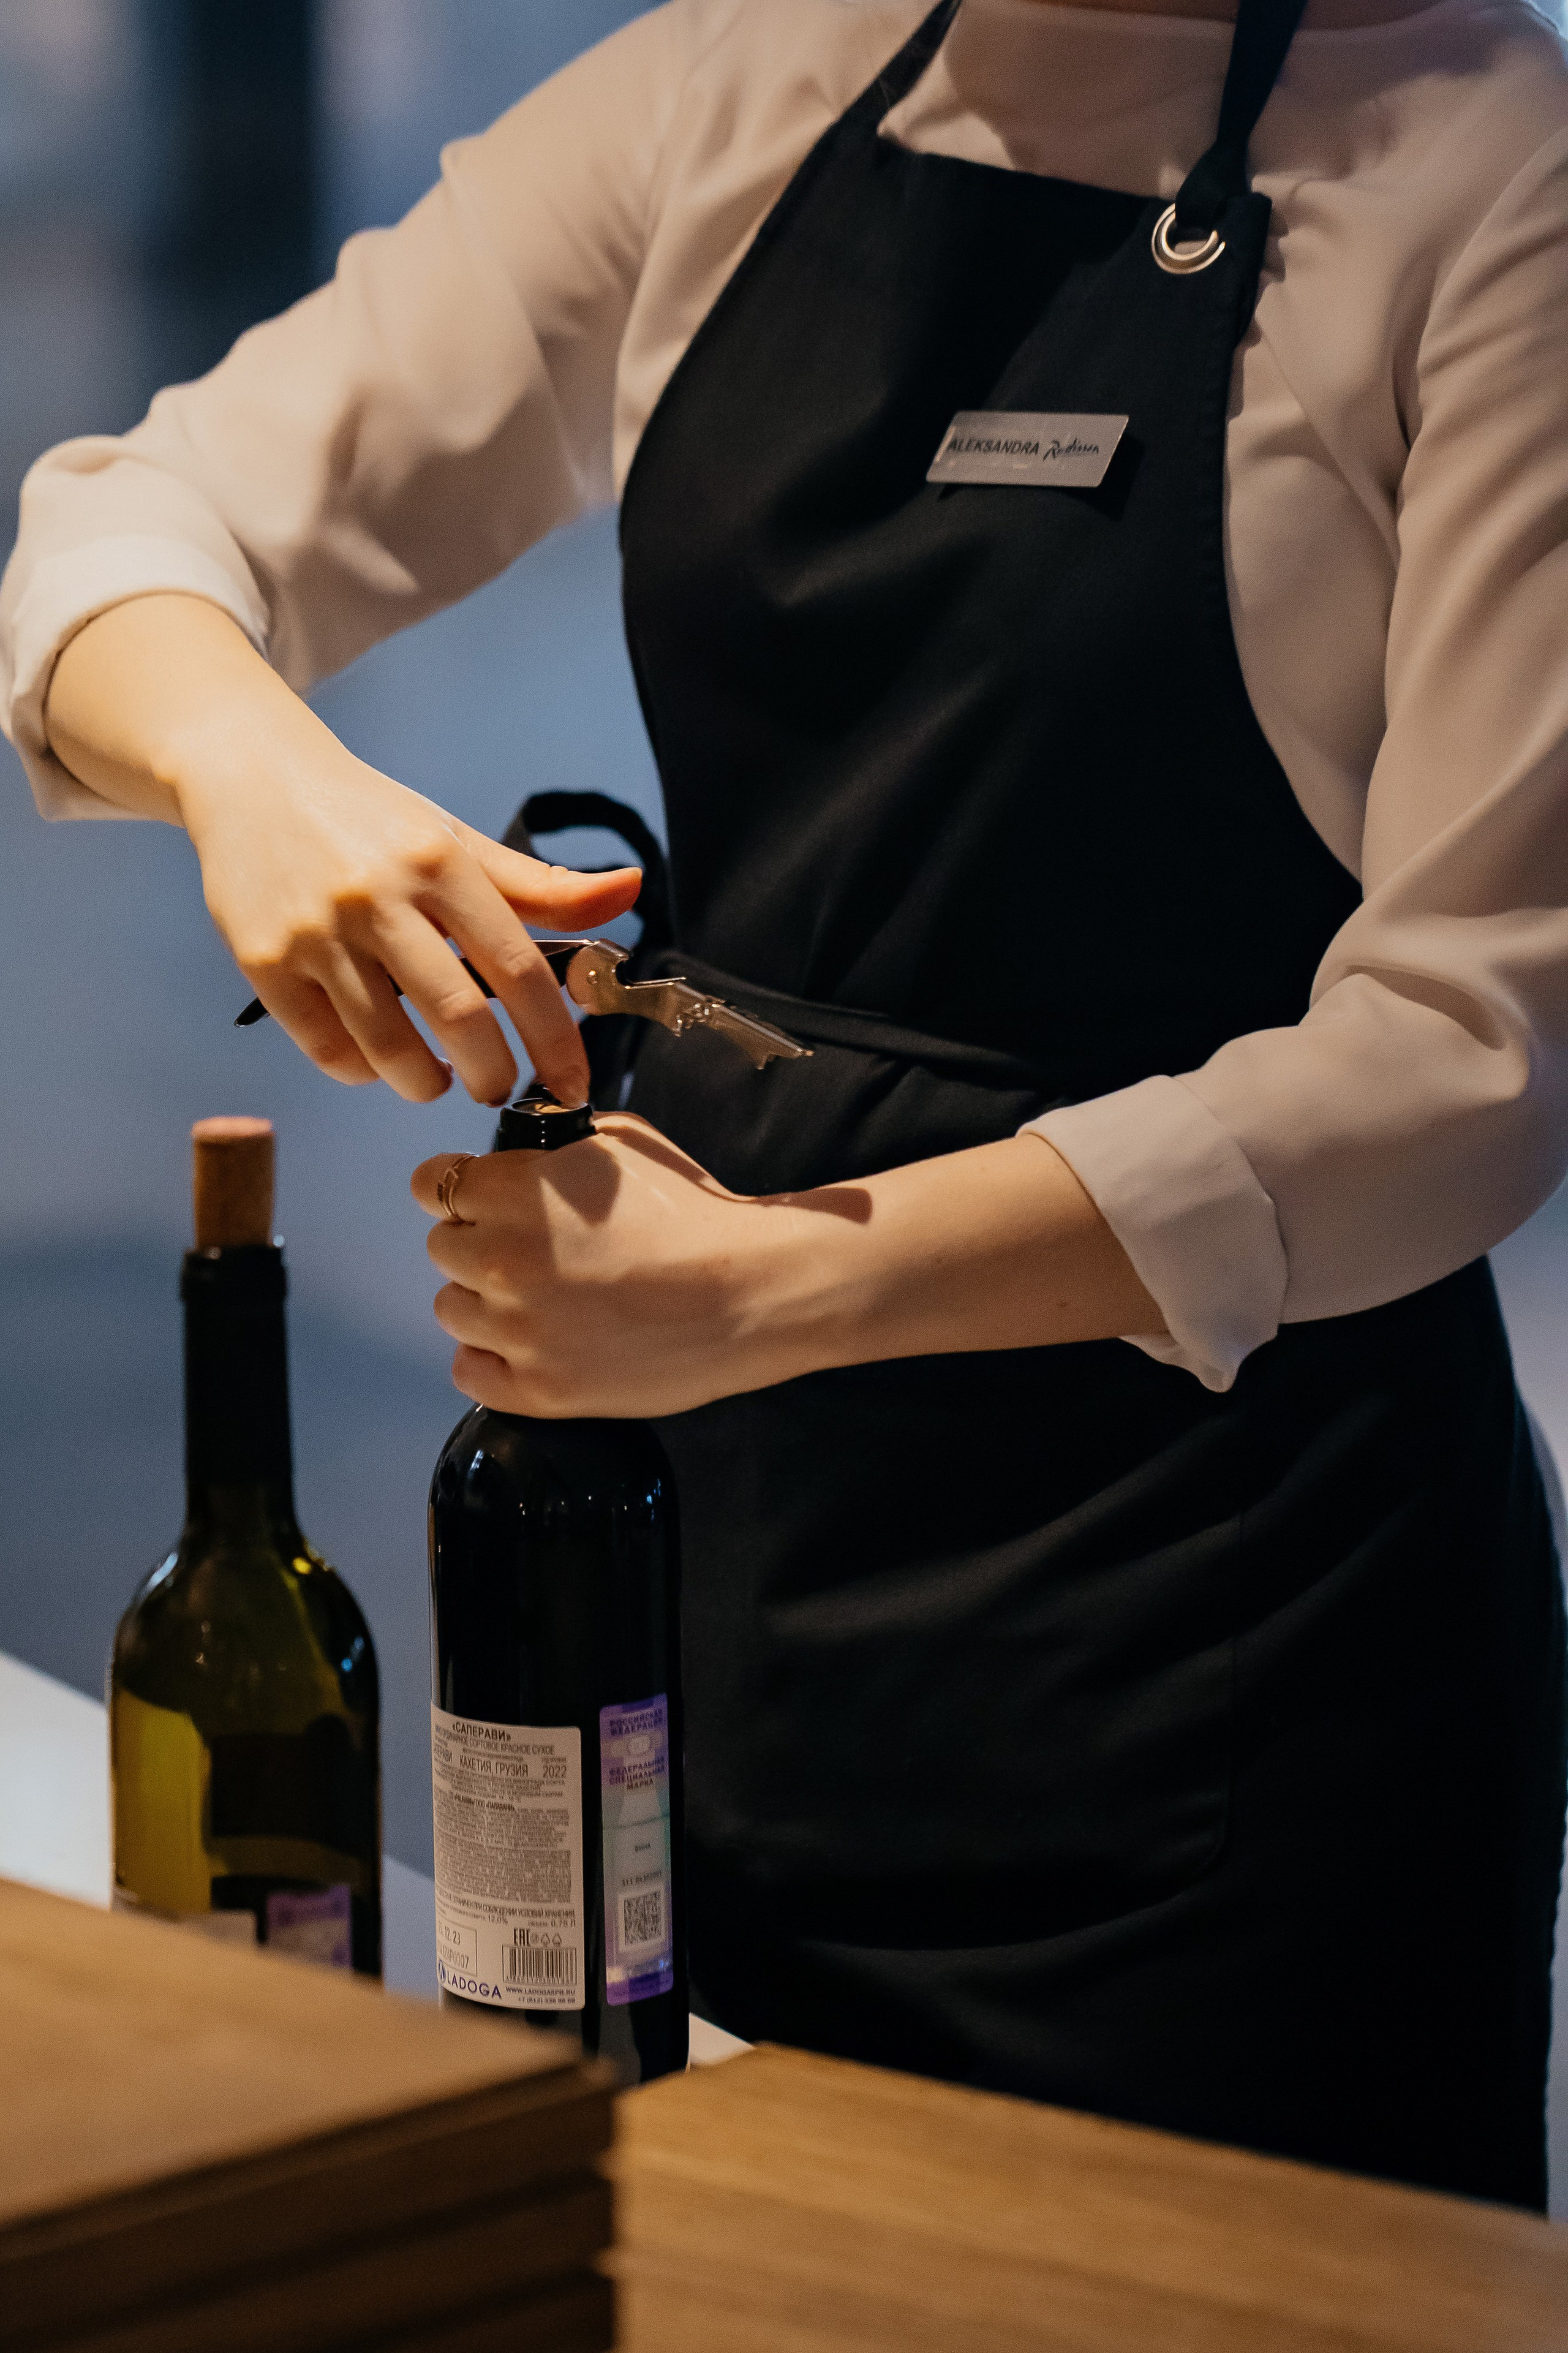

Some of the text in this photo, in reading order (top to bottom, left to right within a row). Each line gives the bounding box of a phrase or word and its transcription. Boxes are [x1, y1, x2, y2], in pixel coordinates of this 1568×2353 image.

[947, 437, 1040, 456] ALEKSANDRA
[452, 1721, 511, 1742] «САПЕРАВИ»
[459, 1754, 494, 1775] КАХЕТИЯ,
[496, 1761, 529, 1777] ГРУЗИЯ
[543, 1764, 567, 1778] 2022
[447, 1970, 502, 2000] LADOGA
